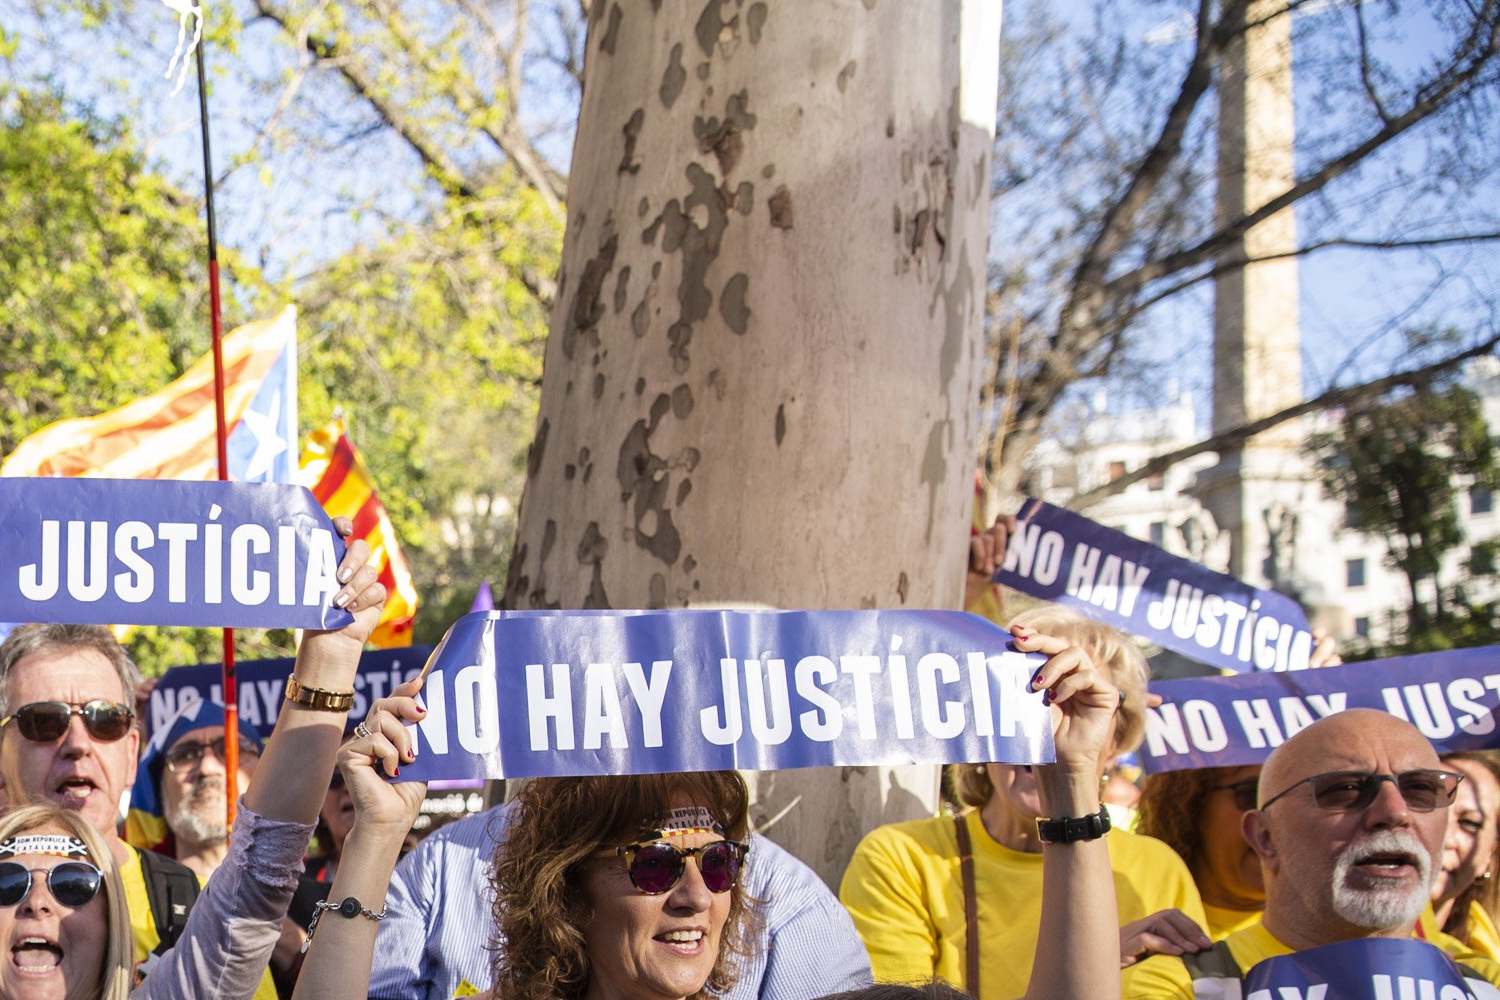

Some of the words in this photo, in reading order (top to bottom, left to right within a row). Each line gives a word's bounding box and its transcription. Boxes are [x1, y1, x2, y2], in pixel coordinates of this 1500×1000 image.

[18, 503, 342, 606] JUSTÍCIA
[1002, 520, 1065, 587] NO
[1066, 542, 1150, 617] HAY
[1147, 578, 1312, 673] JUSTÍCIA
[404, 665, 500, 756] NO
[525, 660, 673, 751] HAY
[699, 634, 1046, 745] JUSTÍCIA
[1144, 698, 1229, 758] NO
